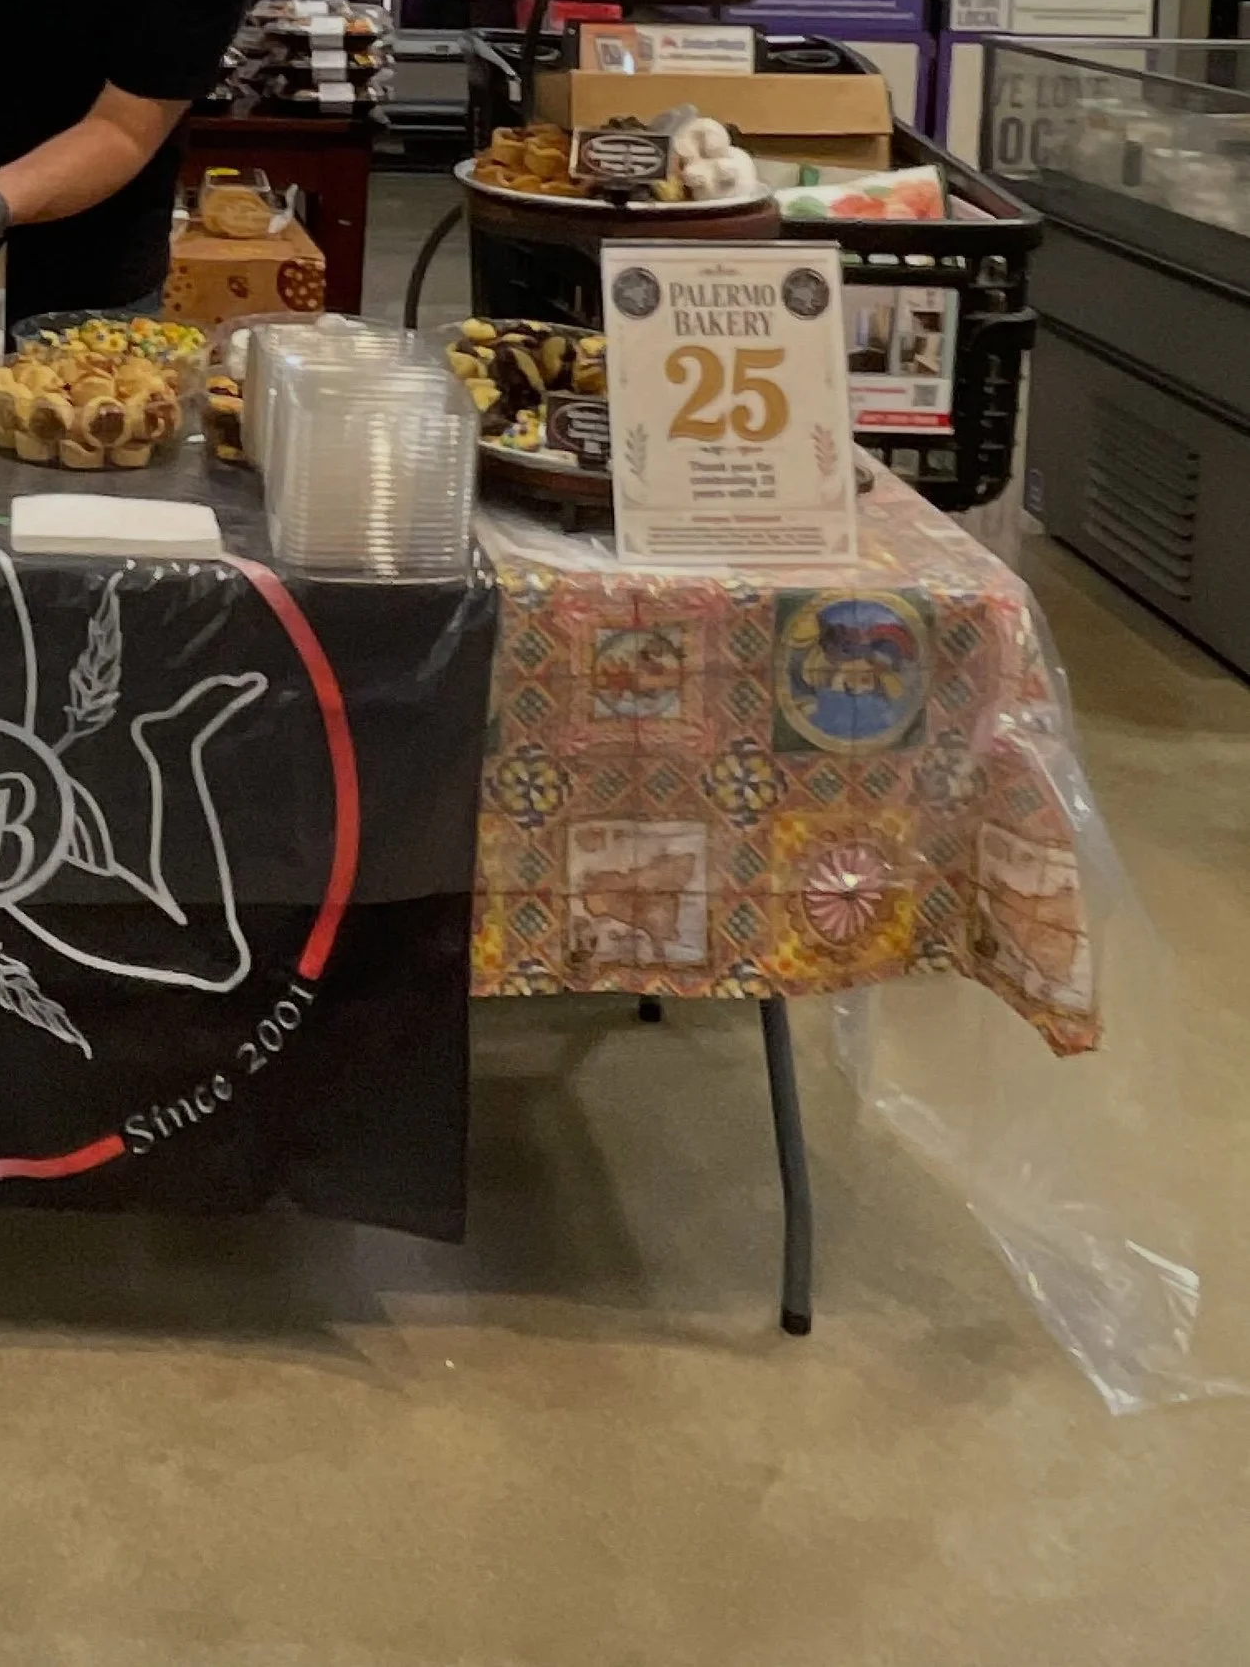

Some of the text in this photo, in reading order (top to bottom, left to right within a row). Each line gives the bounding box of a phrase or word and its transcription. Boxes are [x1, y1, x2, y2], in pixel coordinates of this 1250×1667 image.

[669, 282, 777, 308] PALERMO
[674, 311, 774, 337] BAKERY
[664, 345, 791, 443] 25
[124, 984, 316, 1155] Since 2001
